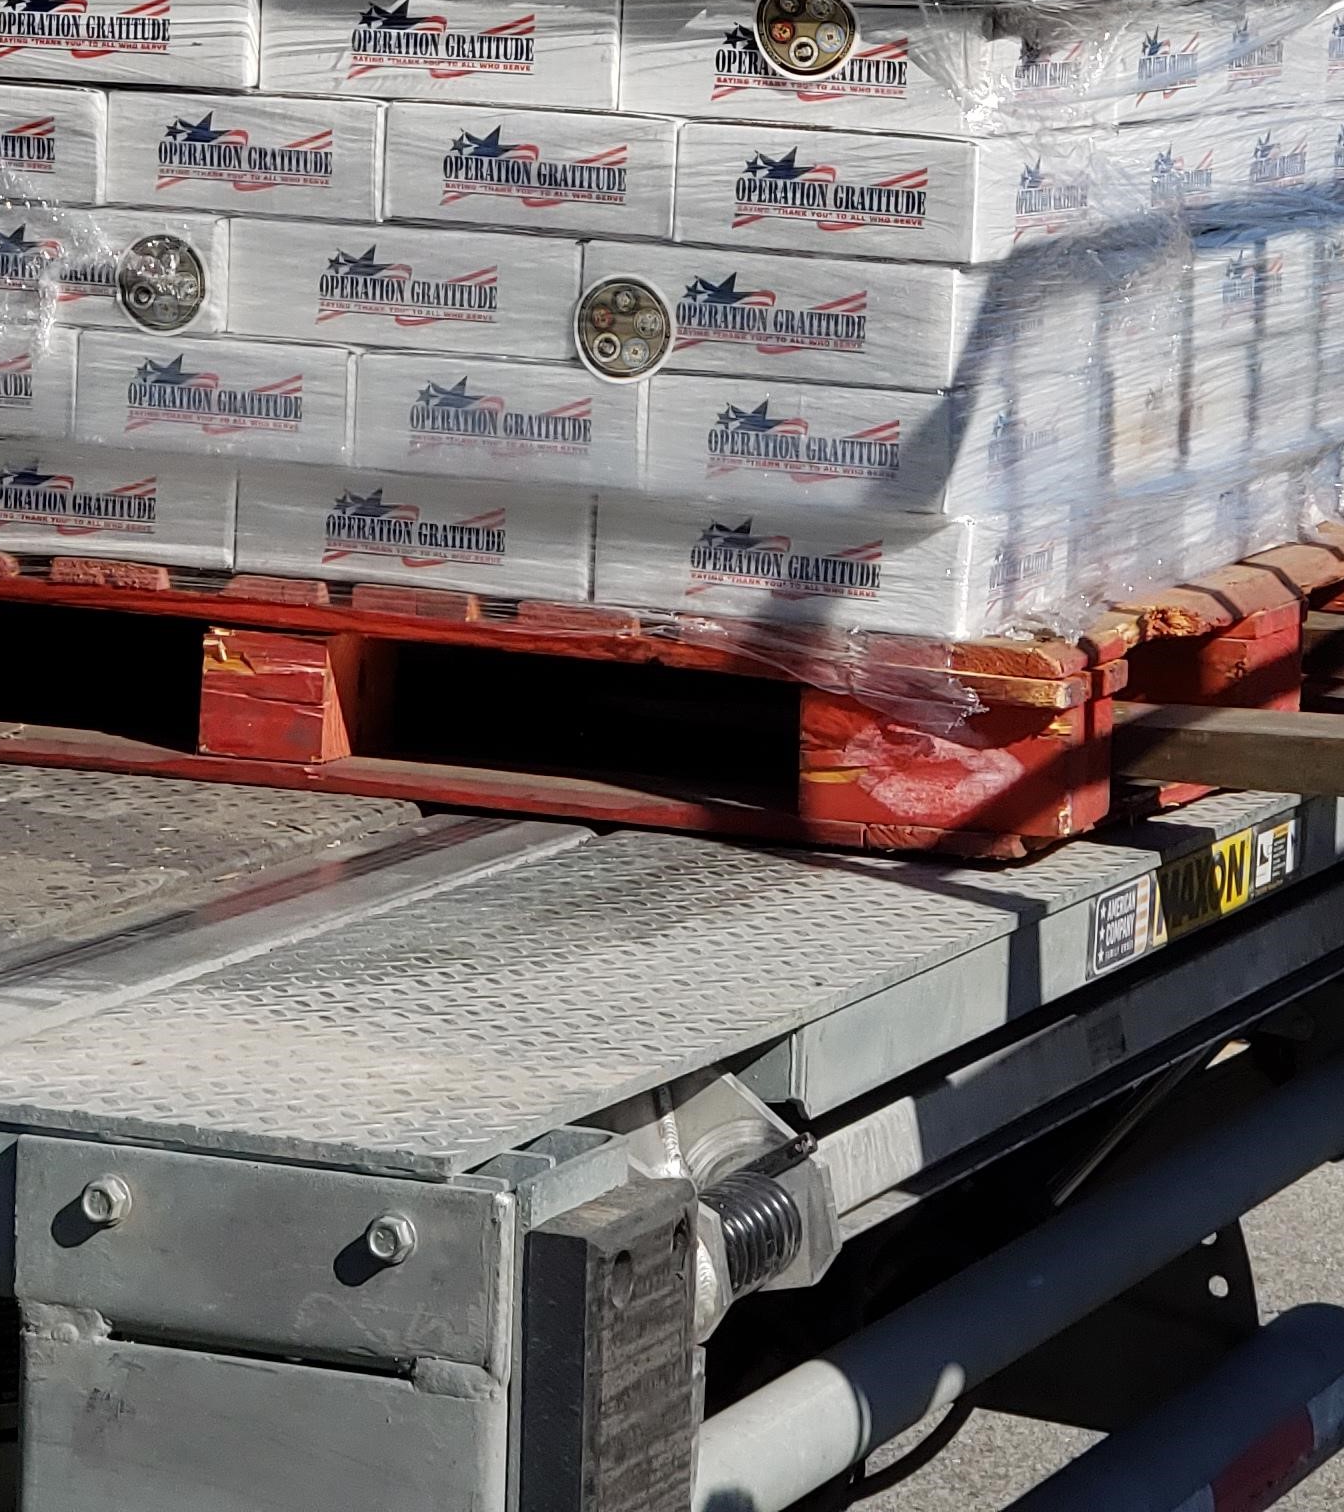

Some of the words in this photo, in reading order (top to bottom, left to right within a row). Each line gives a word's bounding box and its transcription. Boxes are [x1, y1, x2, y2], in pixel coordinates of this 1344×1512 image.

[86, 14, 170, 42] GRATITUDE
[351, 29, 440, 58] OPERATION
[445, 32, 534, 62] GRATITUDE
[158, 141, 242, 170] OPERATION
[247, 145, 332, 175] GRATITUDE
[443, 154, 532, 185] OPERATION
[537, 160, 627, 192] GRATITUDE
[736, 177, 828, 209] OPERATION
[833, 184, 926, 217] GRATITUDE
[319, 274, 406, 303] OPERATION
[411, 280, 497, 310] GRATITUDE
[676, 301, 768, 333] OPERATION
[774, 308, 866, 340] GRATITUDE
[127, 382, 213, 412] OPERATION
[218, 388, 302, 420] GRATITUDE
[410, 405, 498, 436] OPERATION
[503, 411, 592, 443] GRATITUDE
[708, 428, 800, 460] OPERATION
[806, 435, 900, 467] GRATITUDE
[73, 490, 156, 520] GRATITUDE
[326, 514, 413, 545] OPERATION
[418, 522, 505, 553] GRATITUDE
[690, 545, 783, 577] OPERATION
[788, 554, 881, 588] GRATITUDE
[1106, 889, 1136, 920] AMERICAN
[1105, 913, 1136, 947] COMPANY
